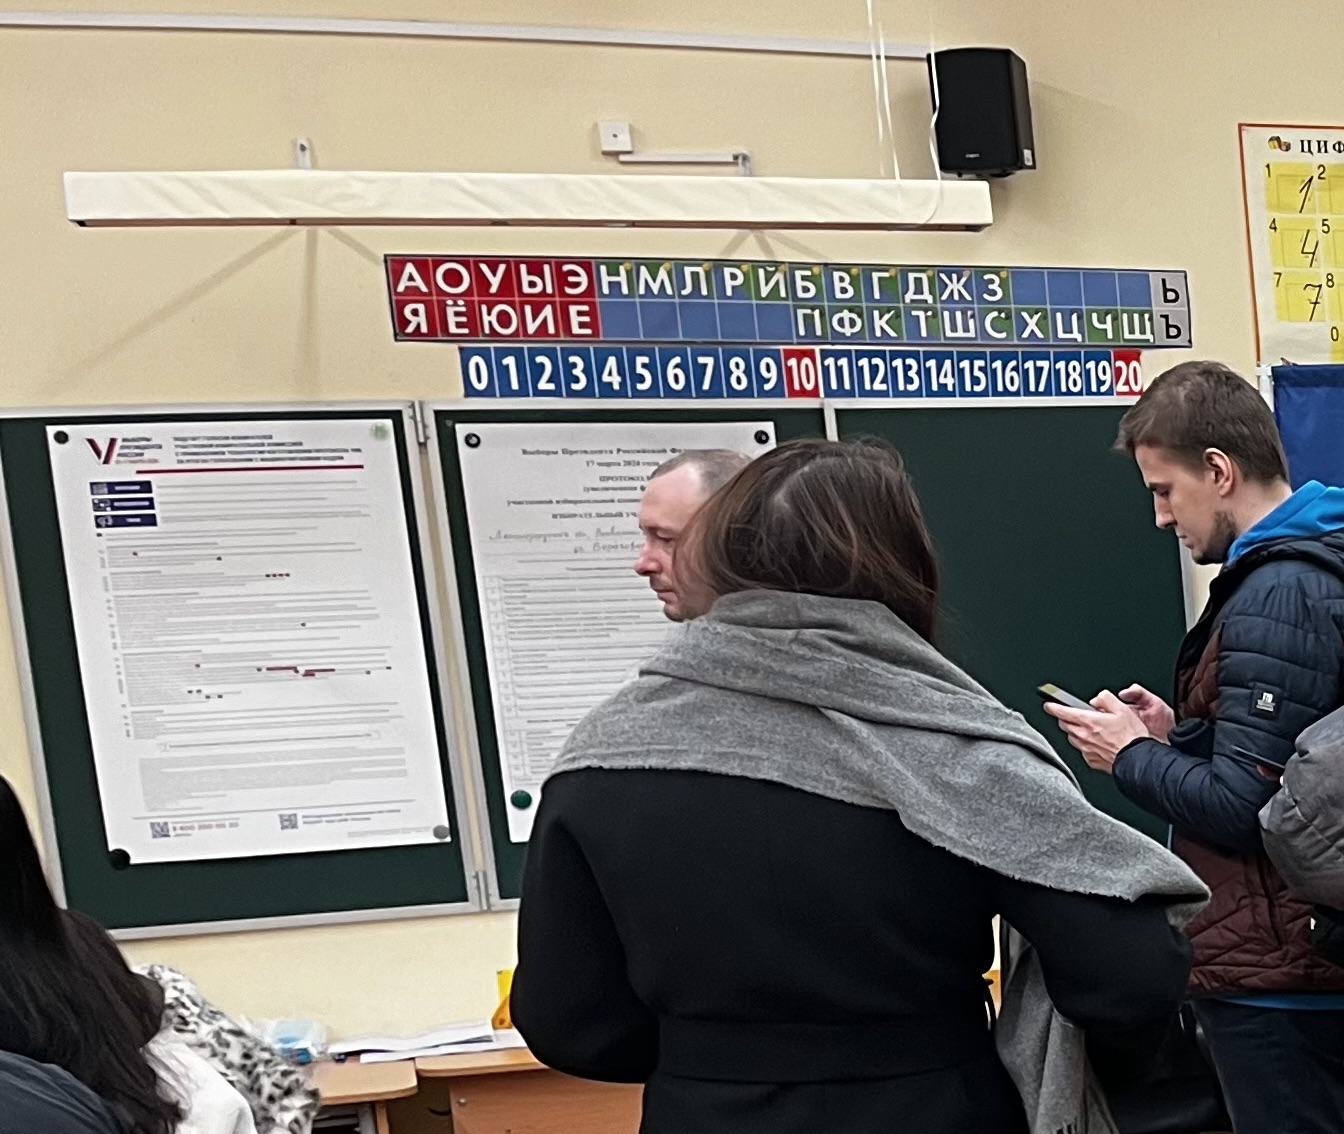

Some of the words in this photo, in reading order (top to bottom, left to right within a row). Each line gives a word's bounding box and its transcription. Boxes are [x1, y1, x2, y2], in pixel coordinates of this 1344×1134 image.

[1266, 164, 1272, 178] 1
[1299, 175, 1314, 214] 1
[1317, 164, 1326, 180] 2
[1269, 218, 1278, 233] 4
[1300, 229, 1319, 268] 4
[1321, 218, 1330, 234] 5
[1274, 272, 1283, 288] 7
[1303, 284, 1323, 322] 7
[1326, 273, 1335, 288] 8
[1330, 326, 1339, 342] 0
[468, 355, 489, 391] 0
[501, 355, 519, 391] 1
[534, 355, 556, 391] 2
[568, 355, 587, 391] 3
[601, 355, 622, 391] 4
[635, 356, 652, 391] 5
[666, 356, 686, 391] 6
[697, 356, 715, 391] 7
[729, 356, 748, 391] 8
[759, 356, 778, 391] 9
[787, 356, 816, 391] 10
[824, 357, 850, 391] 11
[857, 357, 888, 391] 12
[891, 357, 920, 391] 13
[925, 358, 955, 392] 14
[959, 359, 987, 392] 15
[991, 359, 1019, 392] 16
[1024, 360, 1050, 392] 17
[1055, 360, 1082, 393] 18
[1085, 360, 1112, 393] 19
[1114, 360, 1142, 393] 20
